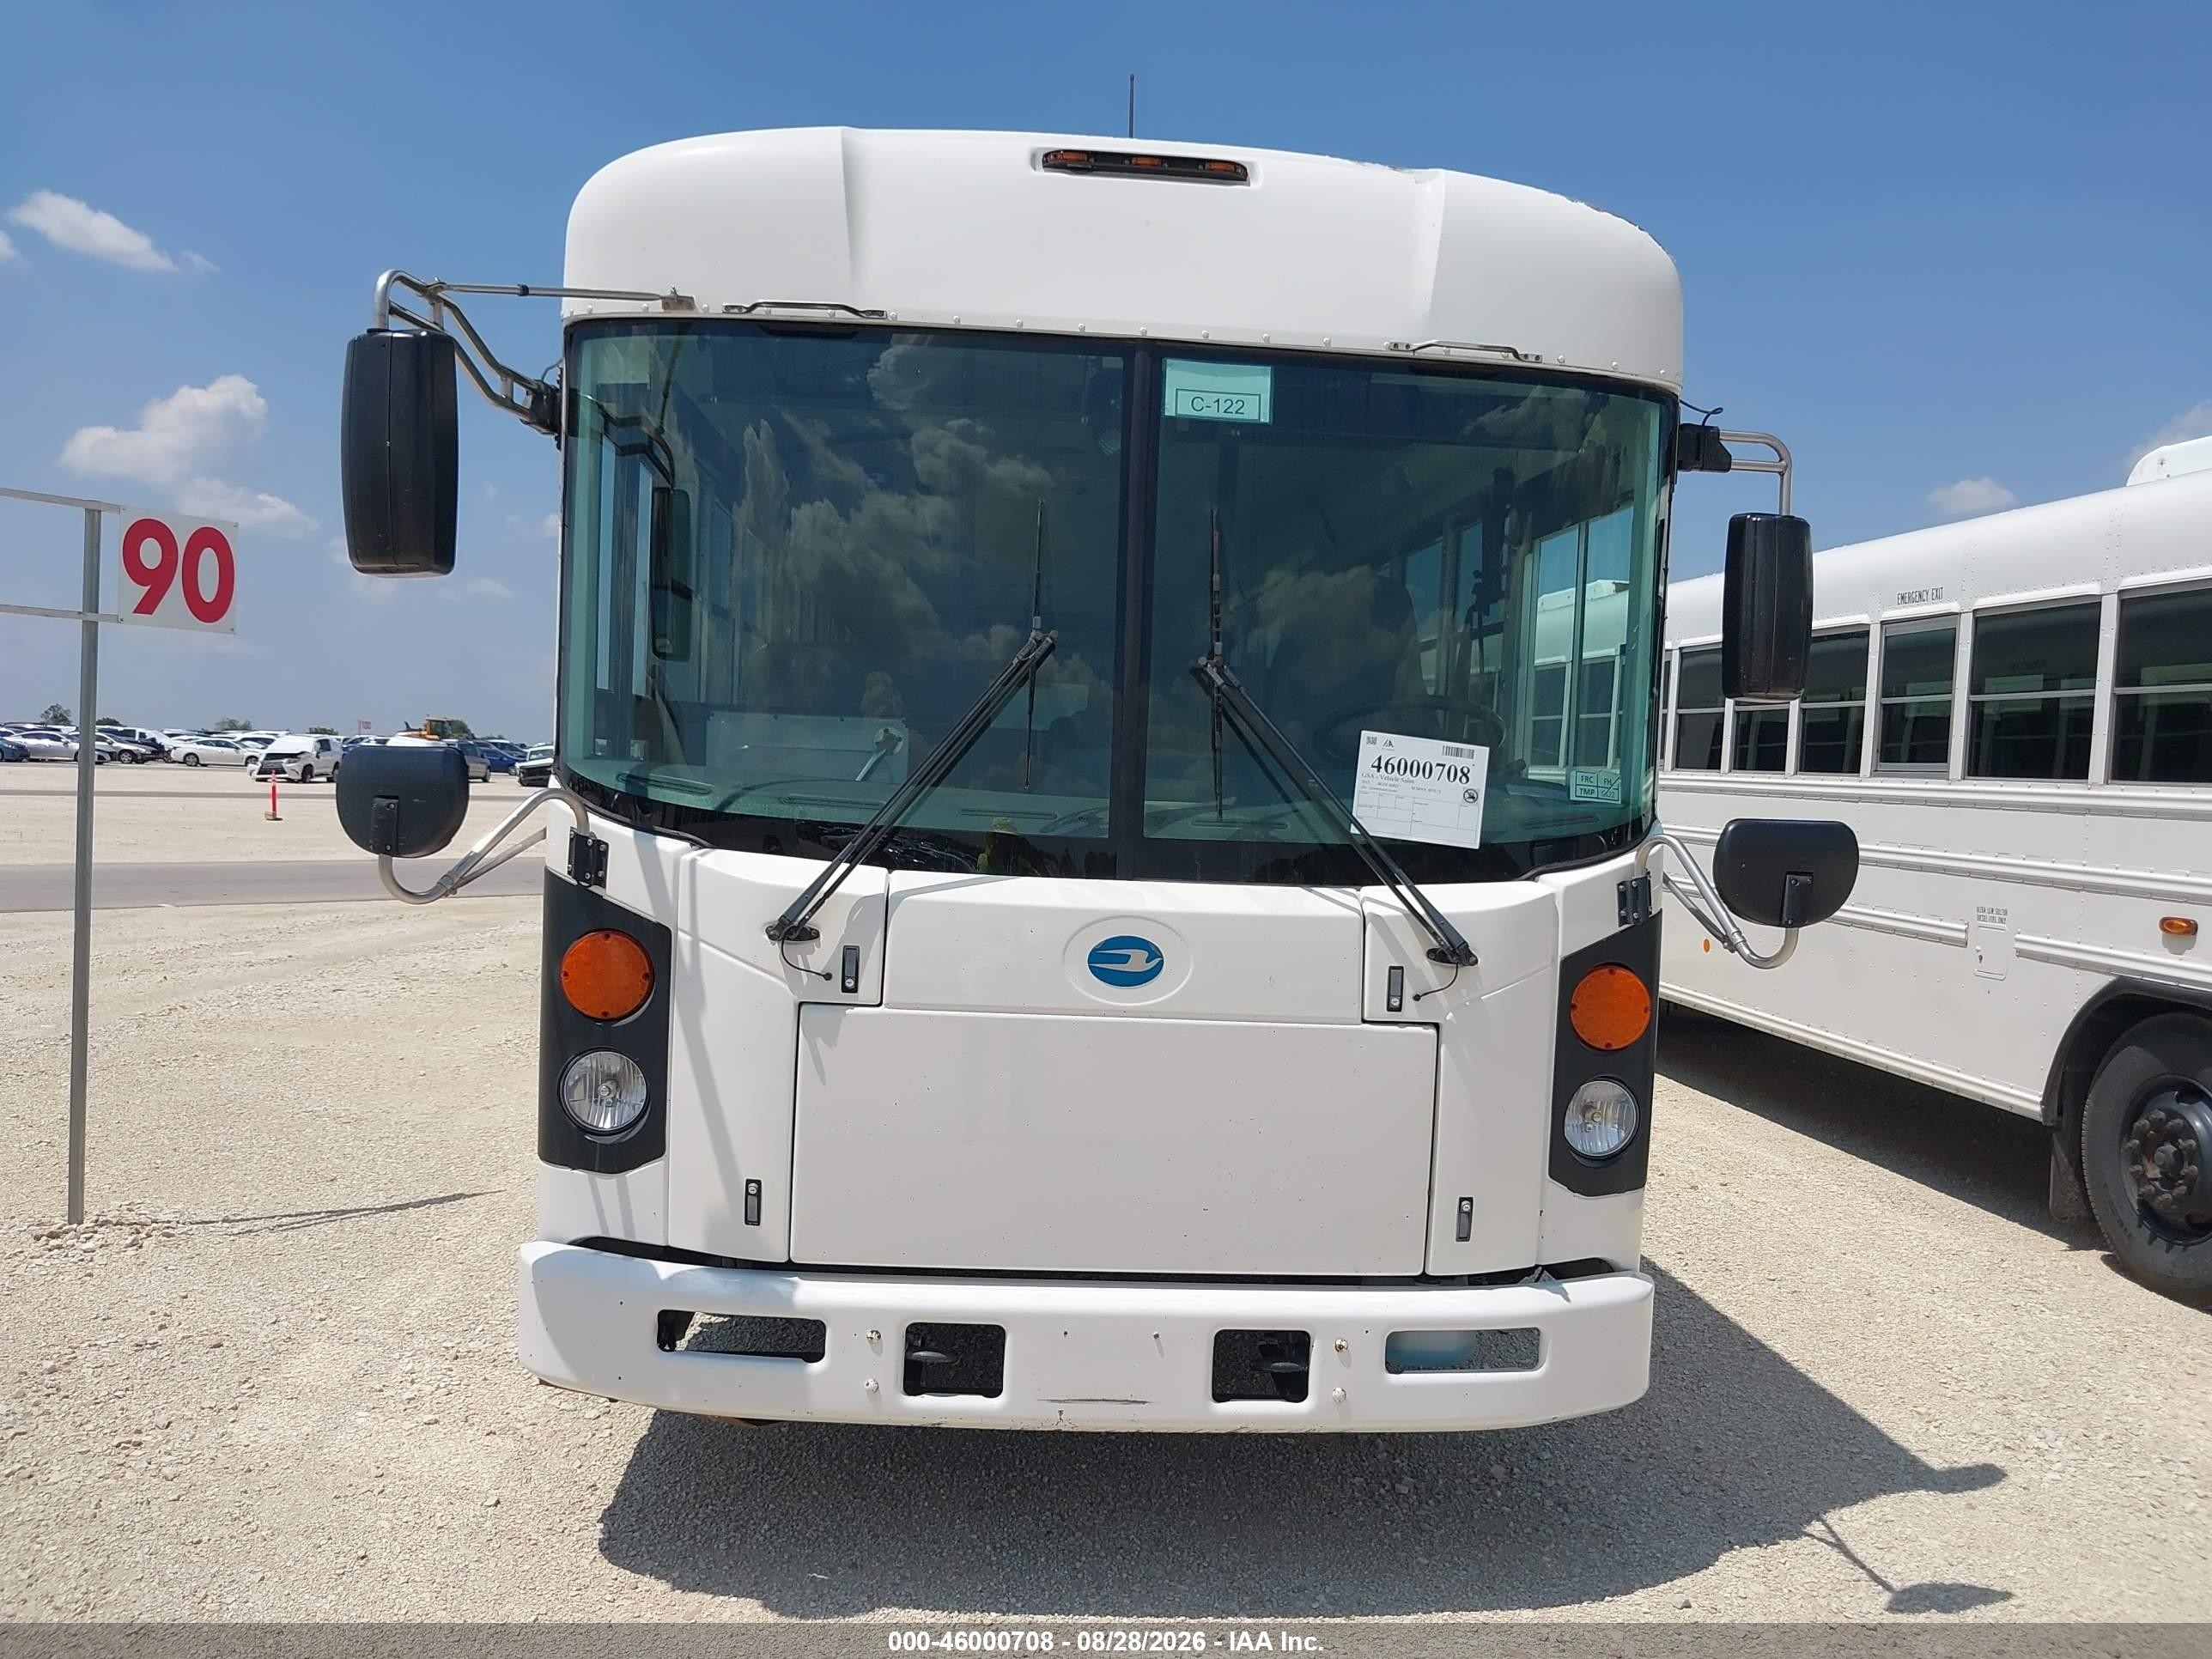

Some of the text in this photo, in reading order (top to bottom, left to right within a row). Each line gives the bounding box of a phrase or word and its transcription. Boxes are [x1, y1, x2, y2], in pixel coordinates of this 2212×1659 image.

[1190, 396, 1246, 415] C-122
[122, 518, 235, 623] 90
[1897, 586, 1944, 605] EMERGENCY EXIT
[1370, 755, 1471, 785] 46000708
